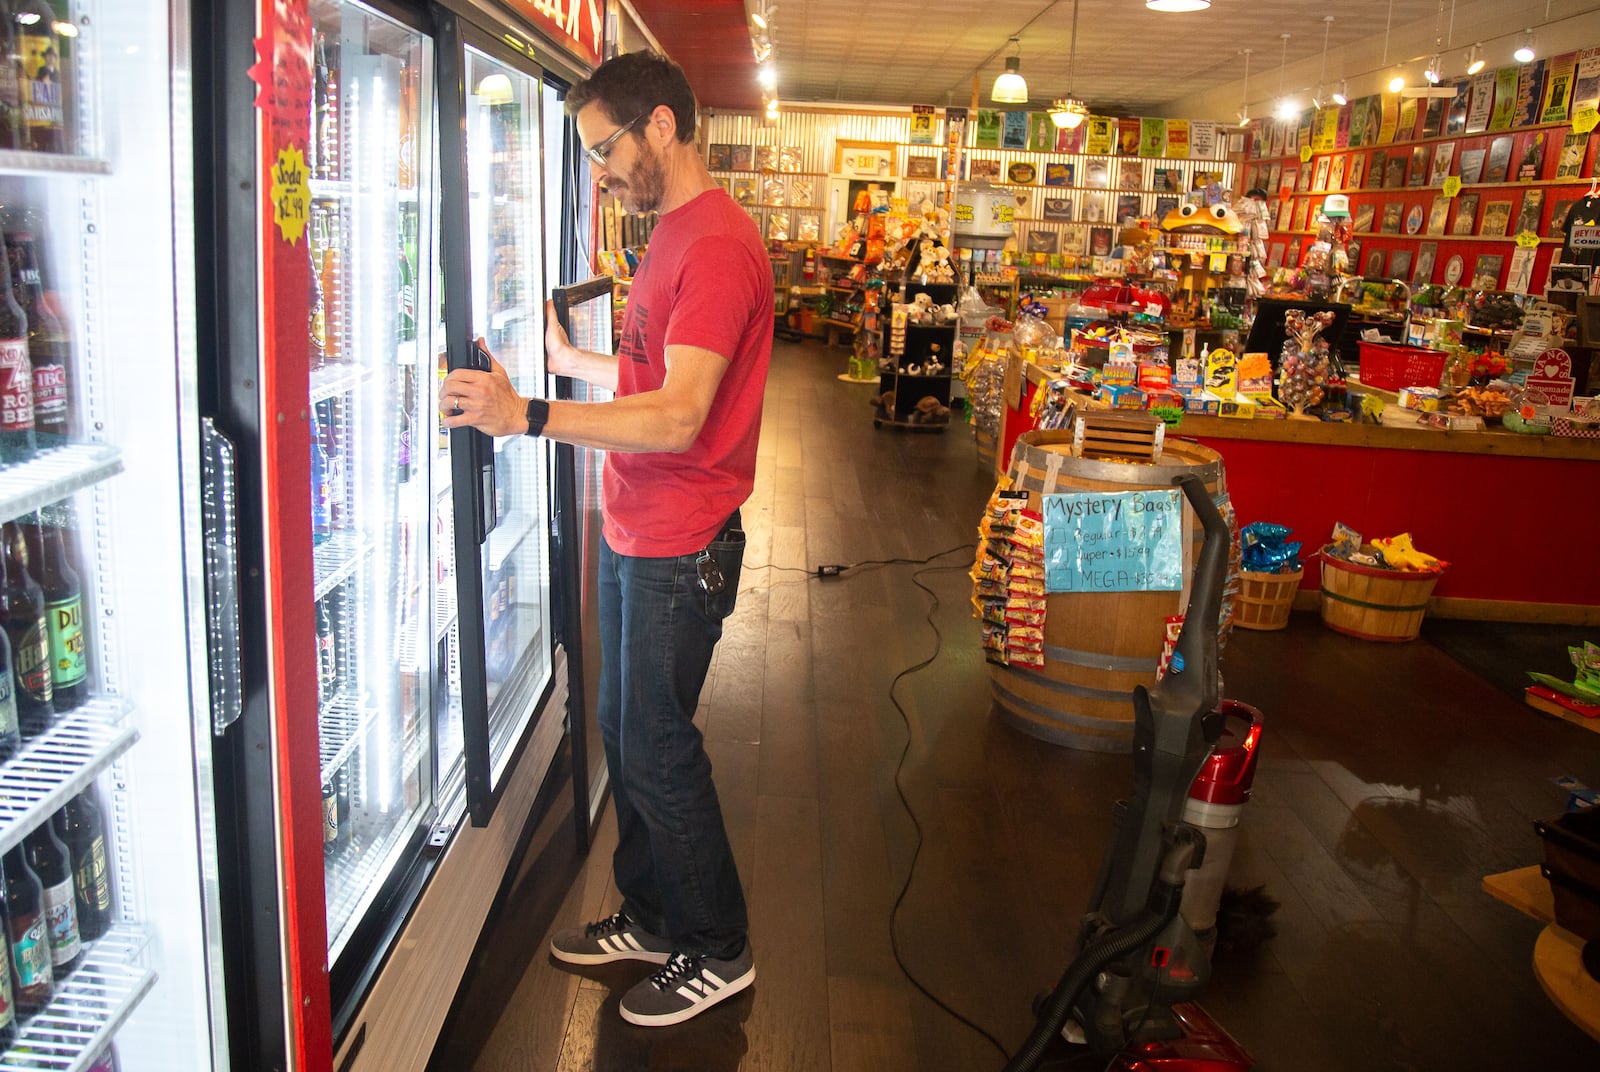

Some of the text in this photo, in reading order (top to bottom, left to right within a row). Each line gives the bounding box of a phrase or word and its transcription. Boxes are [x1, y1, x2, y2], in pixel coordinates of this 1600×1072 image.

[277, 158, 302, 185] Soda
[857, 155, 874, 168] EXIT
[1046, 497, 1122, 523] Mystery
[1081, 570, 1129, 588] MEGA
